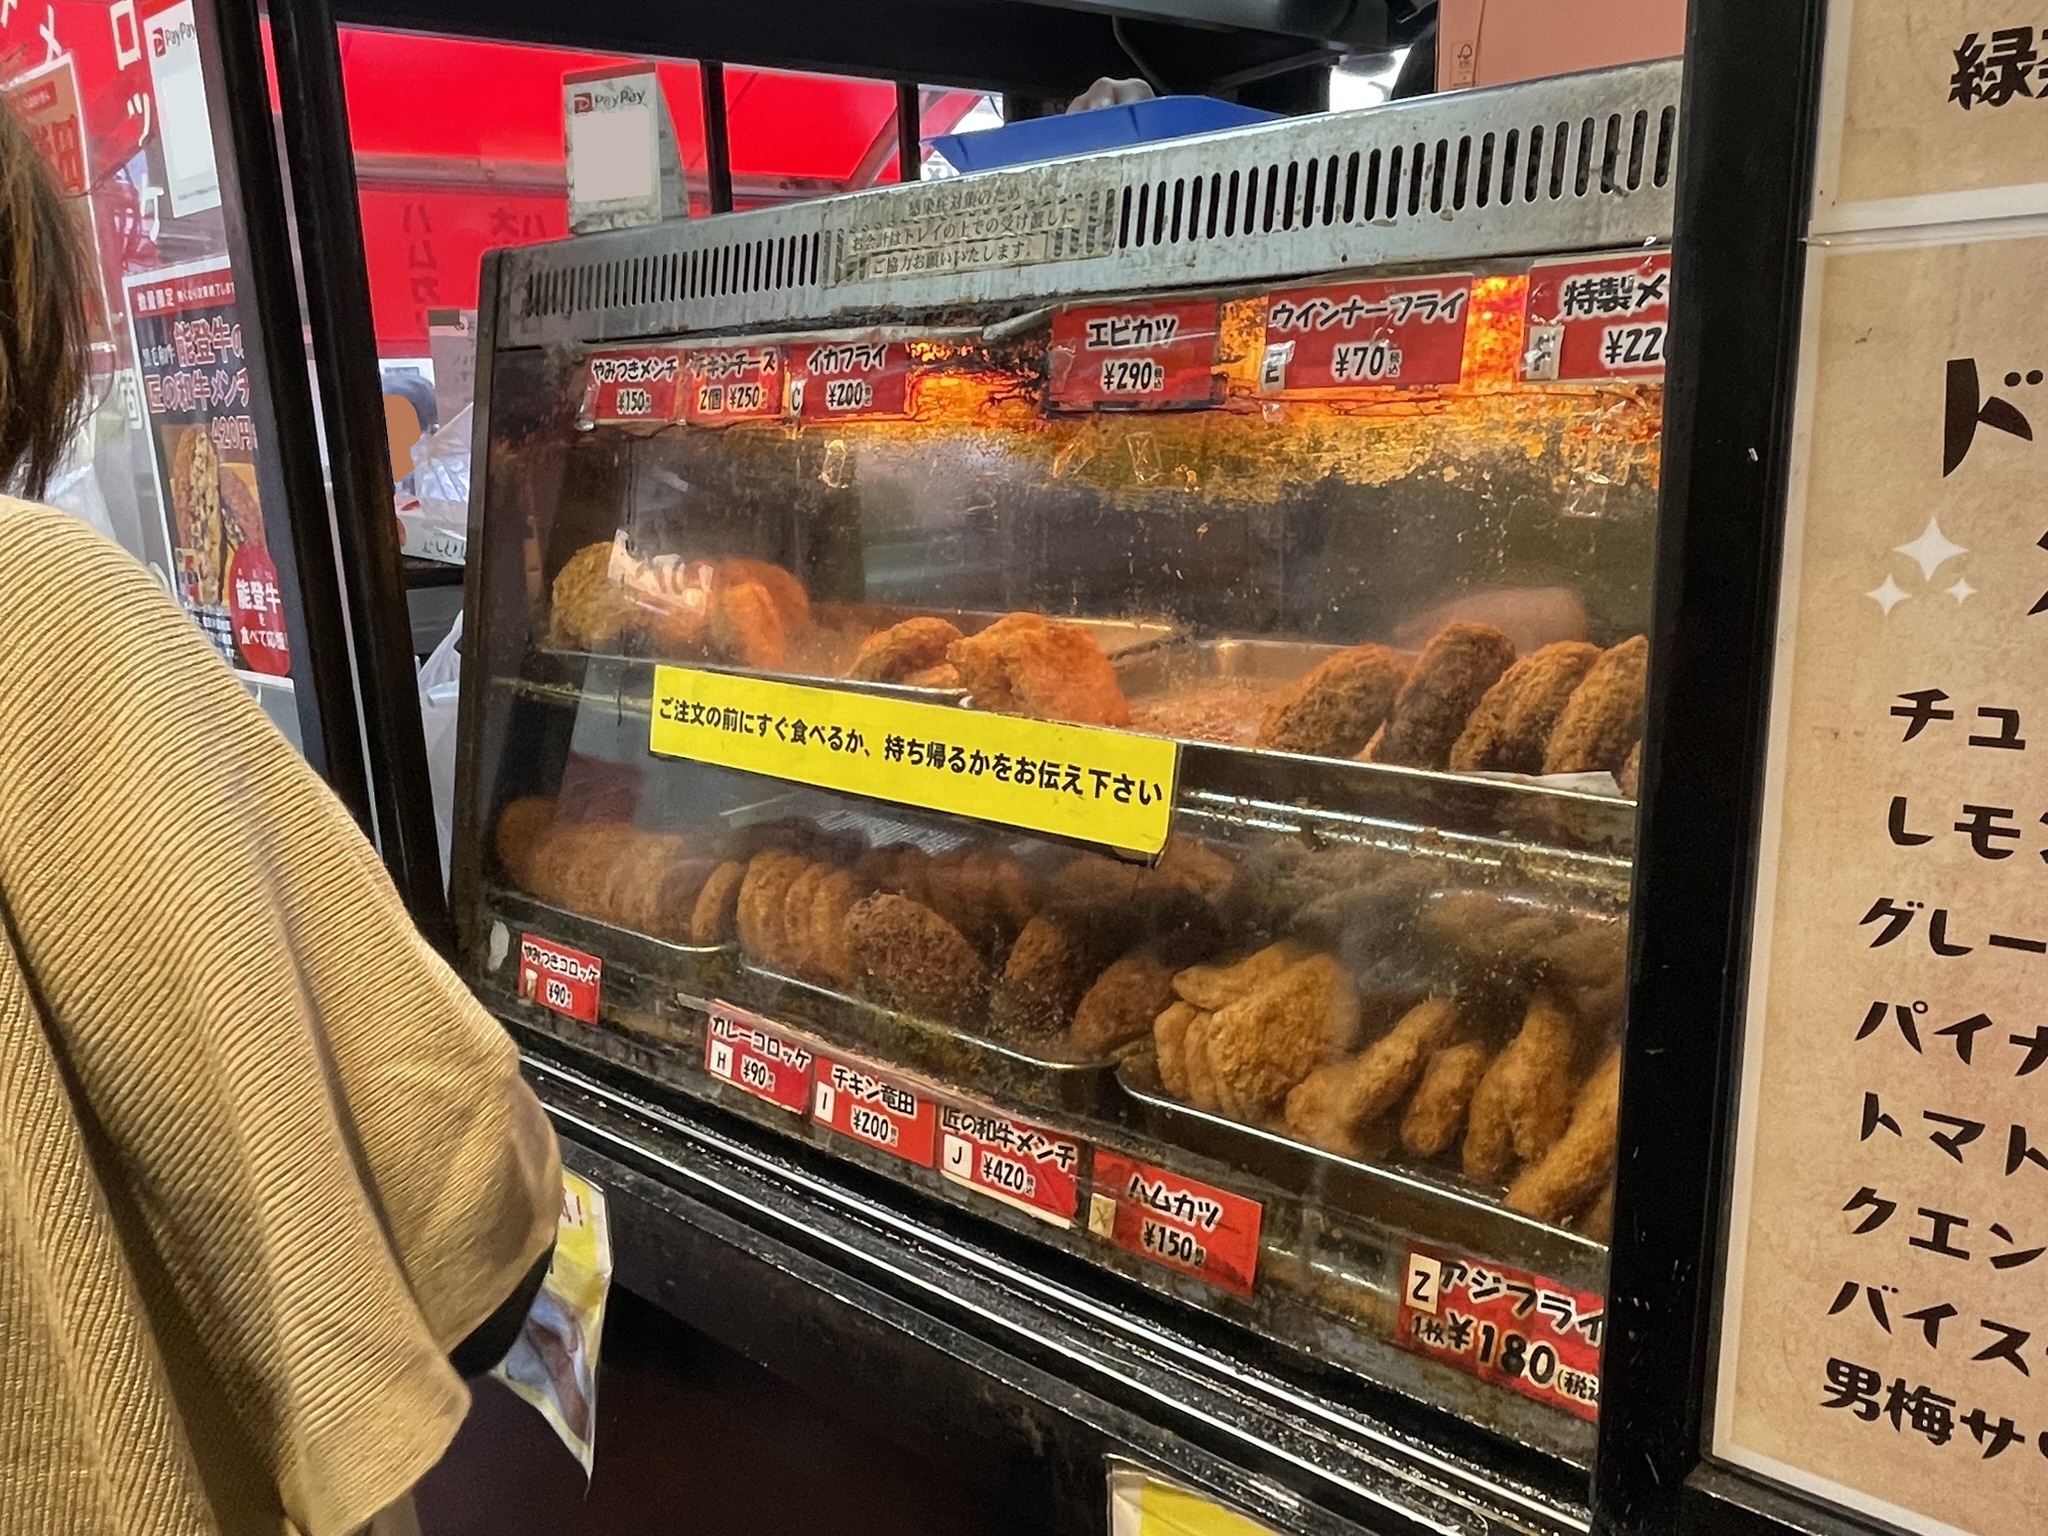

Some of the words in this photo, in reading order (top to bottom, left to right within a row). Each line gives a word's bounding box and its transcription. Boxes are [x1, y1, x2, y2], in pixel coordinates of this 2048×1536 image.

[164, 20, 196, 47] PayPay
[1947, 26, 2048, 111] 緑
[594, 88, 647, 109] PayPay
[851, 207, 1076, 251] お会計はトレイの上での受け渡しに
[1271, 290, 1466, 330] ウインナーフライ
[1562, 273, 1668, 317] 特製メ
[1087, 317, 1177, 348] エビカツ
[1604, 326, 1671, 365] ¥22
[592, 358, 678, 381] やみつきメンチ
[808, 342, 888, 373] イカフライ
[1103, 361, 1152, 392] ¥290
[1333, 345, 1386, 378] ¥70
[617, 389, 646, 412] ¥150
[700, 387, 722, 412] 2個
[728, 385, 761, 410] ¥250
[827, 381, 864, 408] ¥200
[1942, 357, 2044, 478] ド
[235, 577, 281, 614] 能登牛
[658, 696, 1163, 806] ご注文の前にすぐ食べるか、持ち帰るかをお伝え下さい
[1887, 795, 2048, 860] レモ
[1858, 897, 2048, 957] グレー
[523, 943, 599, 984] やみつきコロッケ
[547, 981, 567, 1006] ¥90
[712, 1016, 810, 1071] カレーコロッケ
[716, 1050, 727, 1071] H
[743, 1057, 767, 1087] ¥90
[833, 1067, 916, 1117] チキン竜田
[853, 1107, 890, 1142] ¥200
[942, 1106, 1077, 1170] 匠の和牛メンチ
[1860, 1090, 2048, 1177] トマト
[951, 1146, 963, 1166] J
[982, 1153, 1025, 1192] ¥420
[1128, 1175, 1220, 1229] ハムカツ
[1143, 1220, 1194, 1263] ¥150
[1841, 1185, 2047, 1271] クエン
[1440, 1260, 1603, 1342] アジフライ
[1826, 1280, 2048, 1378] バイス
[1820, 1357, 2048, 1461] 男梅サ
